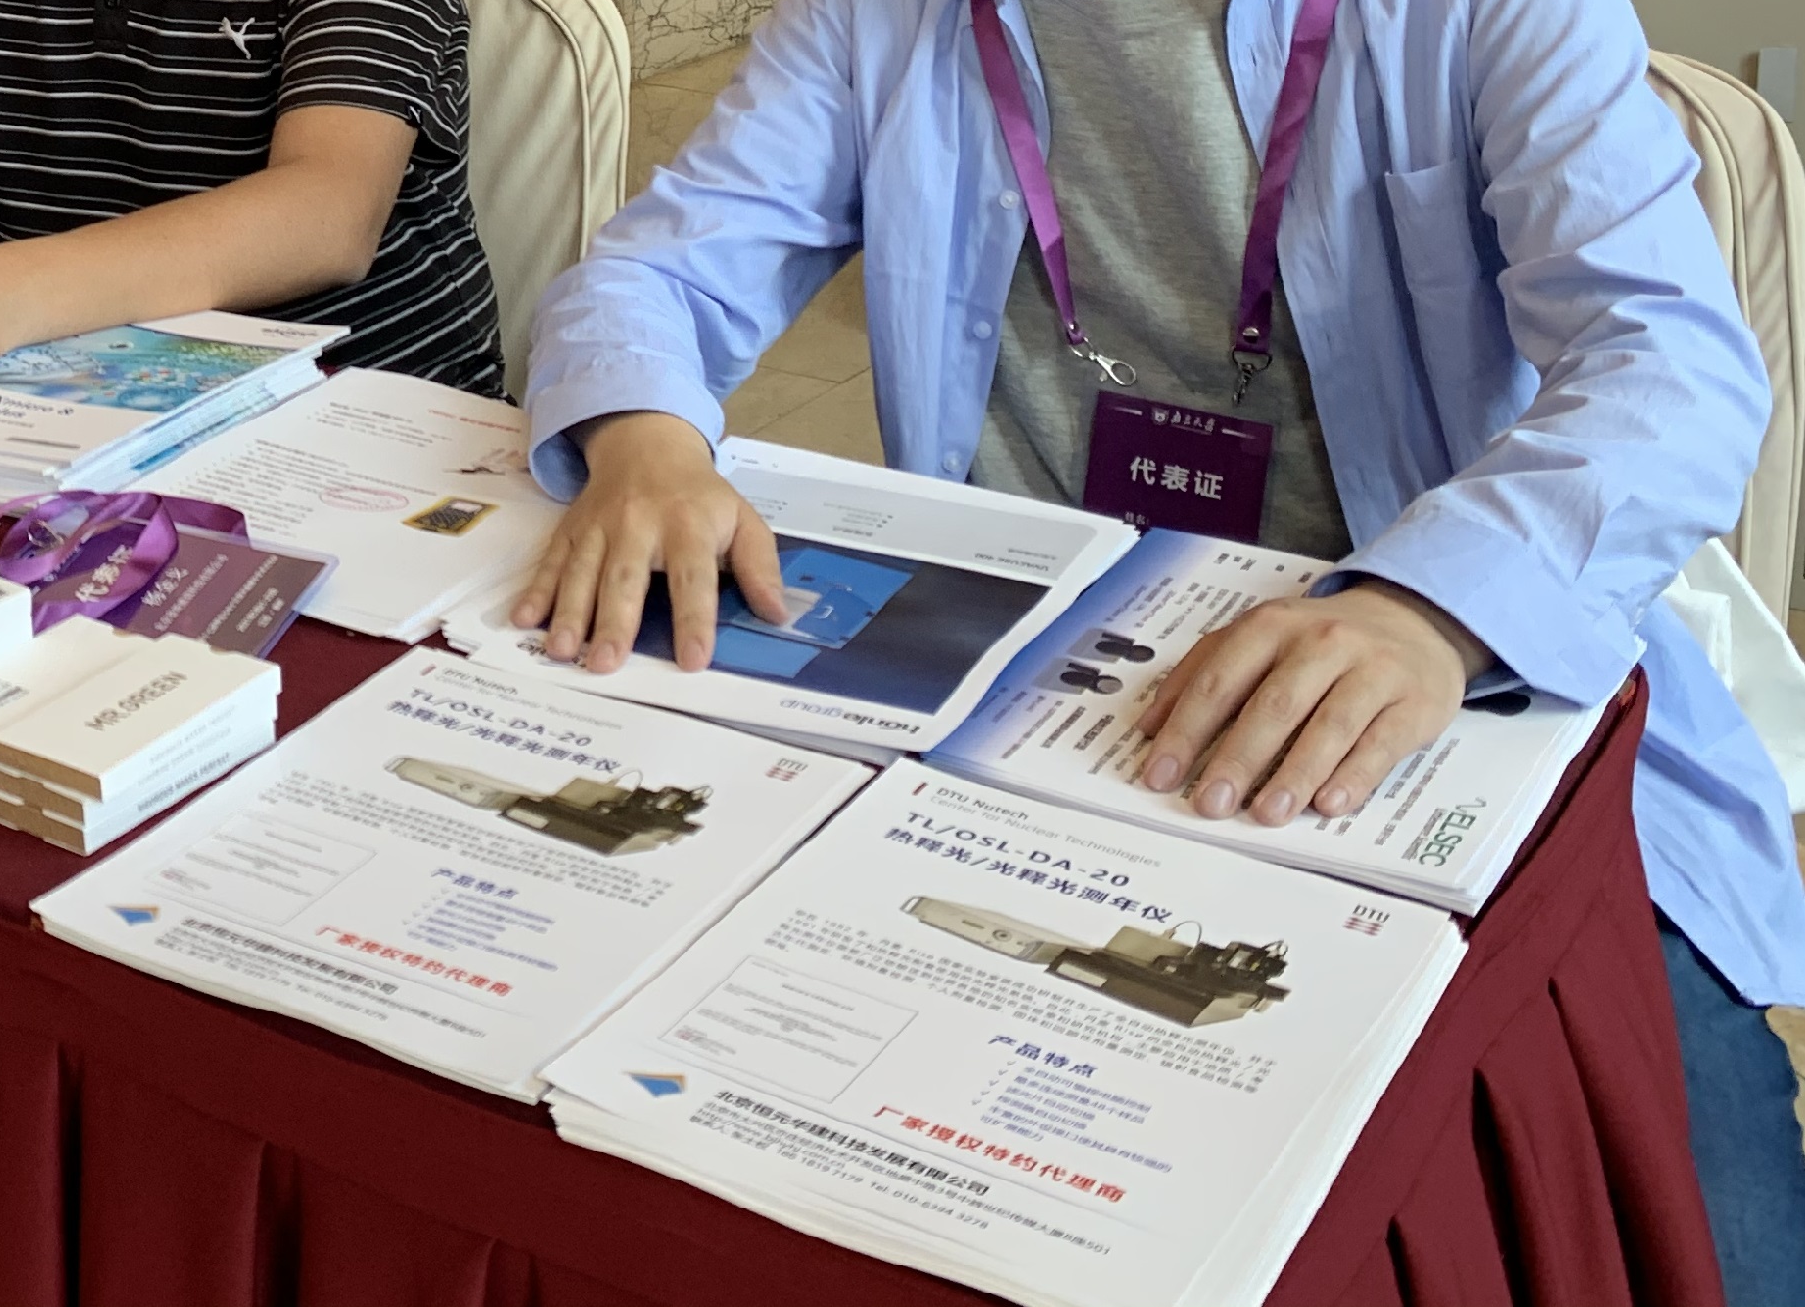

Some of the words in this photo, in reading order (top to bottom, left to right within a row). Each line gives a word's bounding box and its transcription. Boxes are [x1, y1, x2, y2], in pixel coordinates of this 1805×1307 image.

[1129, 455, 1224, 501] 代表证
[84, 670, 187, 732] MR.GREEN
[972, 798, 1029, 821] Nutech
[906, 811, 1131, 887] TL/OSL-DA-20
[1352, 903, 1390, 924] DTU
[988, 1035, 1099, 1079] 产品特点
[872, 1105, 1127, 1204] 厂家授权特约代理商
